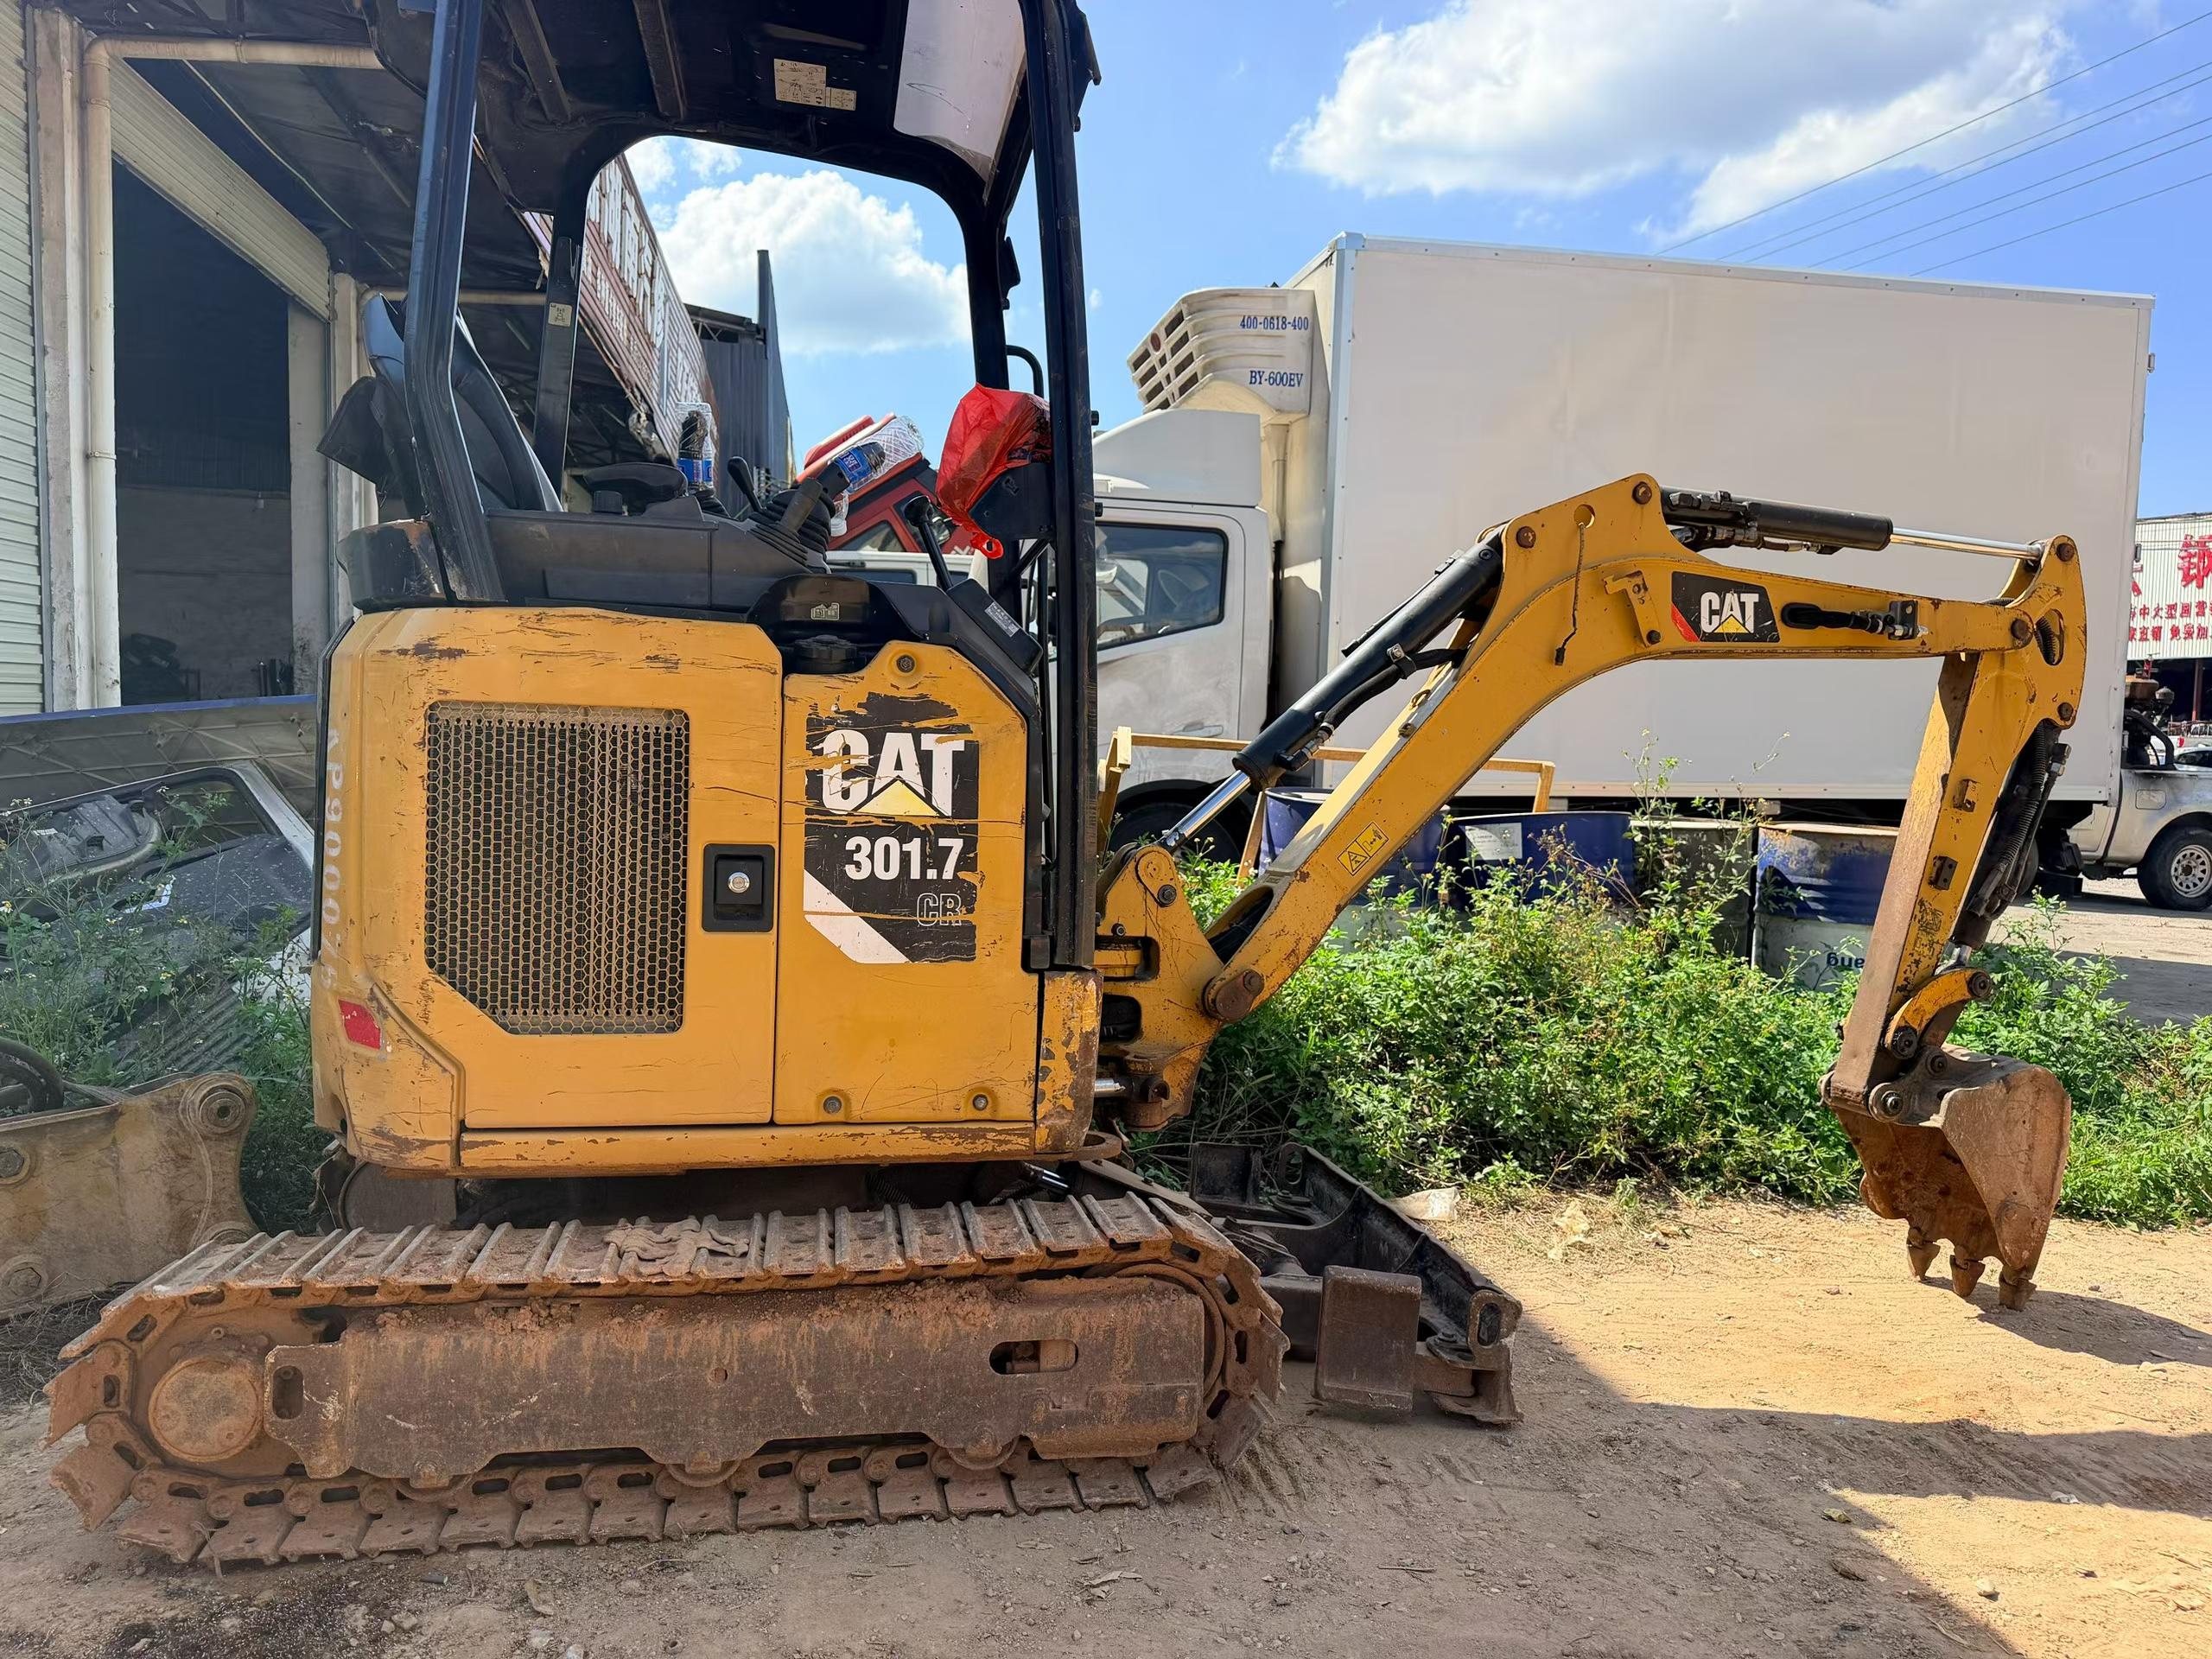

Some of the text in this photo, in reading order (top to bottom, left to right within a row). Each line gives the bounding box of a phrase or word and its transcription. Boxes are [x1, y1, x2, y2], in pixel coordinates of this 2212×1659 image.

[1240, 315, 1309, 331] 400-0618-400
[1249, 369, 1304, 388] BY-600EV
[1700, 591, 1759, 633] CAT
[822, 729, 965, 817] CAT
[845, 836, 964, 880] 301.7
[916, 893, 963, 927] CR
